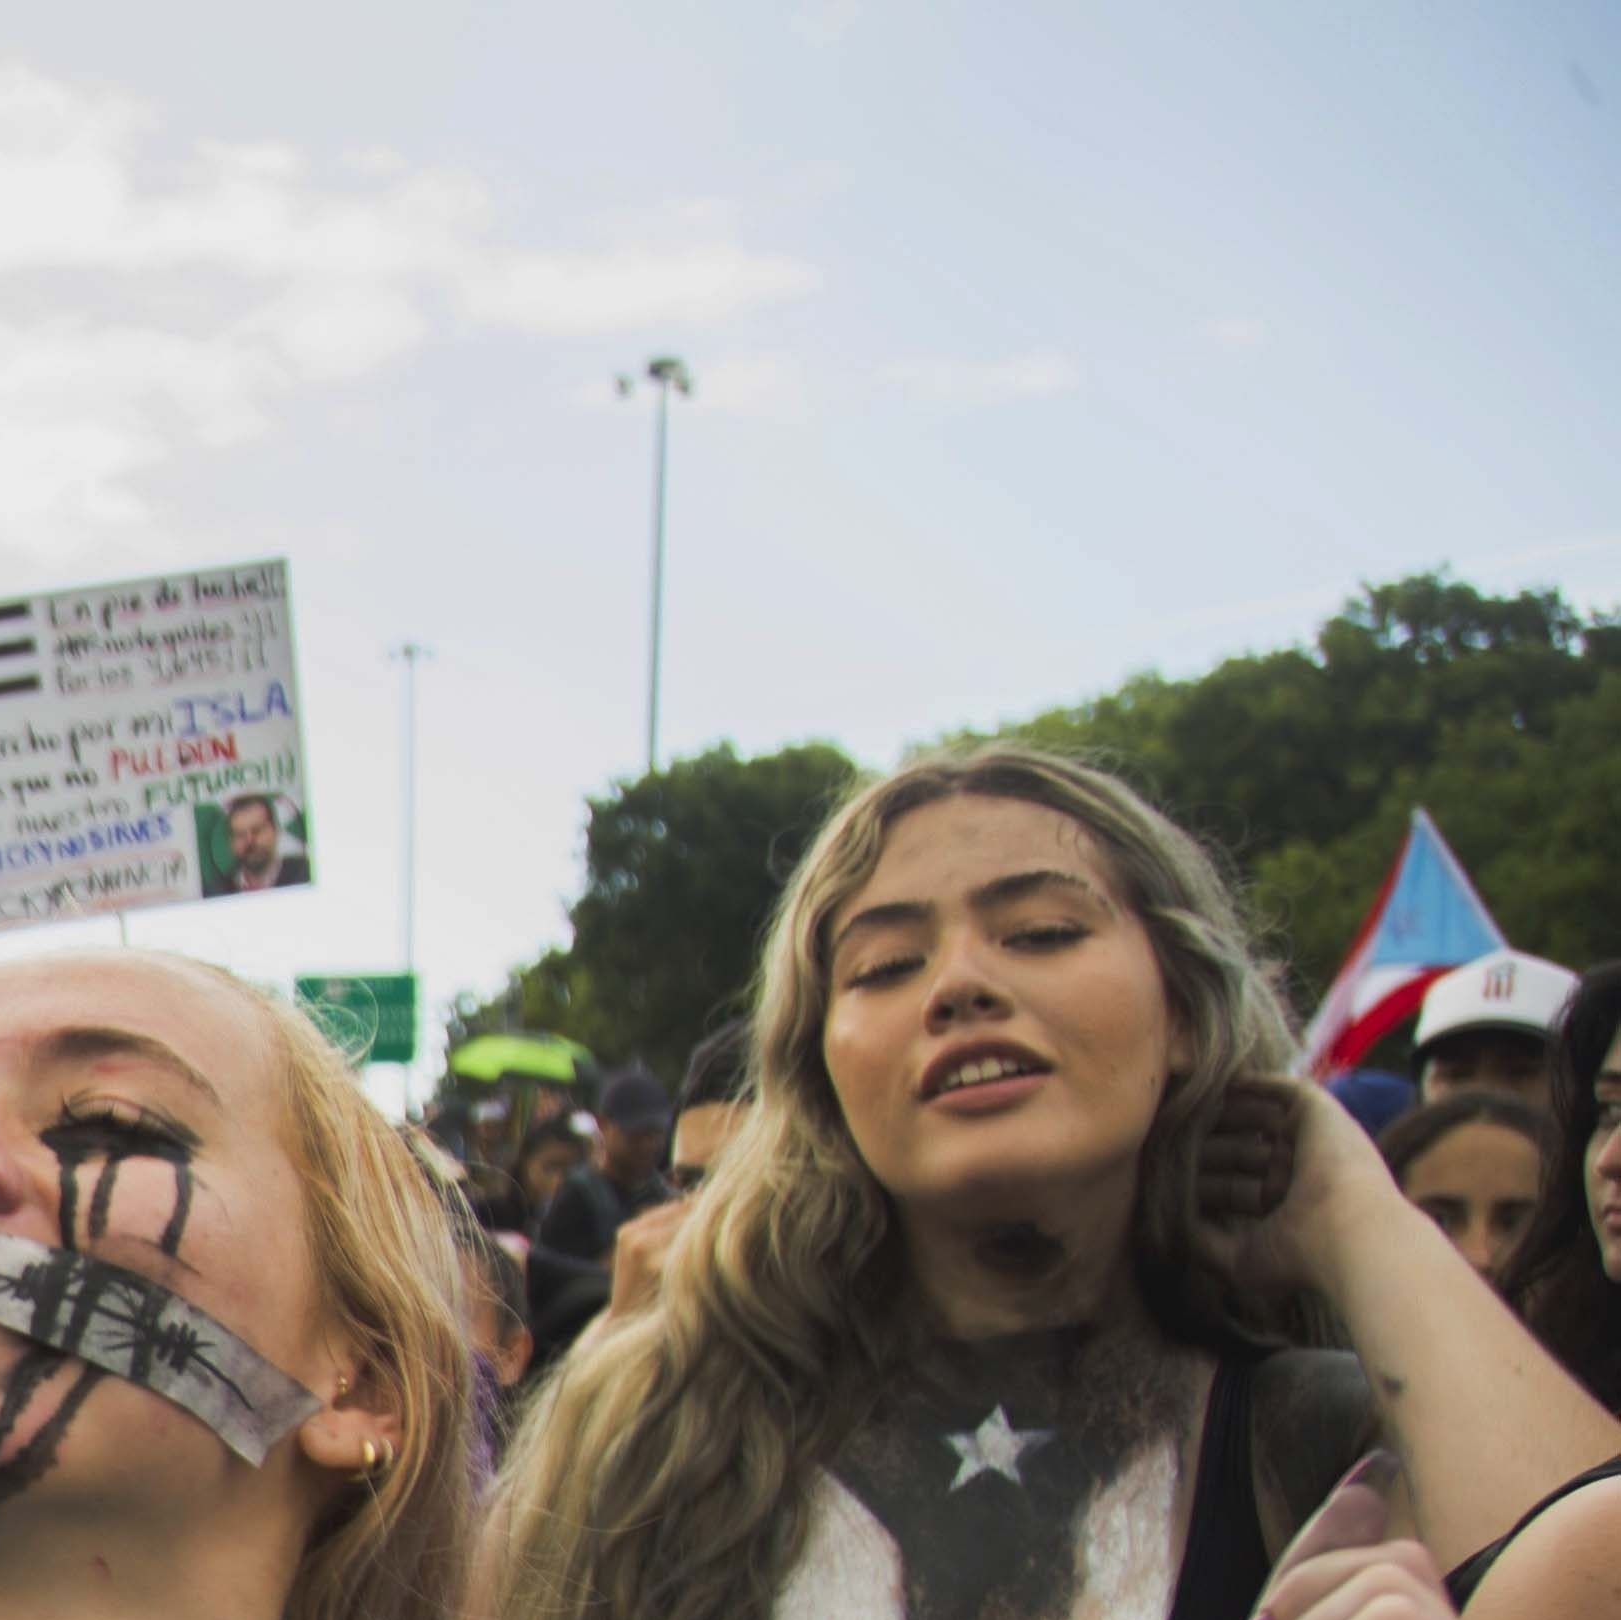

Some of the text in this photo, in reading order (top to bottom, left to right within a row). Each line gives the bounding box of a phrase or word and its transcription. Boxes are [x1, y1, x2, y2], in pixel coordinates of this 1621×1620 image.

[100, 592, 143, 632] pie
[155, 576, 183, 613] de
[67, 715, 113, 770] por
[130, 709, 173, 738] mi
[172, 680, 294, 738] ISLA
[8, 773, 52, 808] que
[62, 766, 100, 789] no
[106, 728, 239, 785] PUEDEN
[15, 795, 130, 836] nuestro
